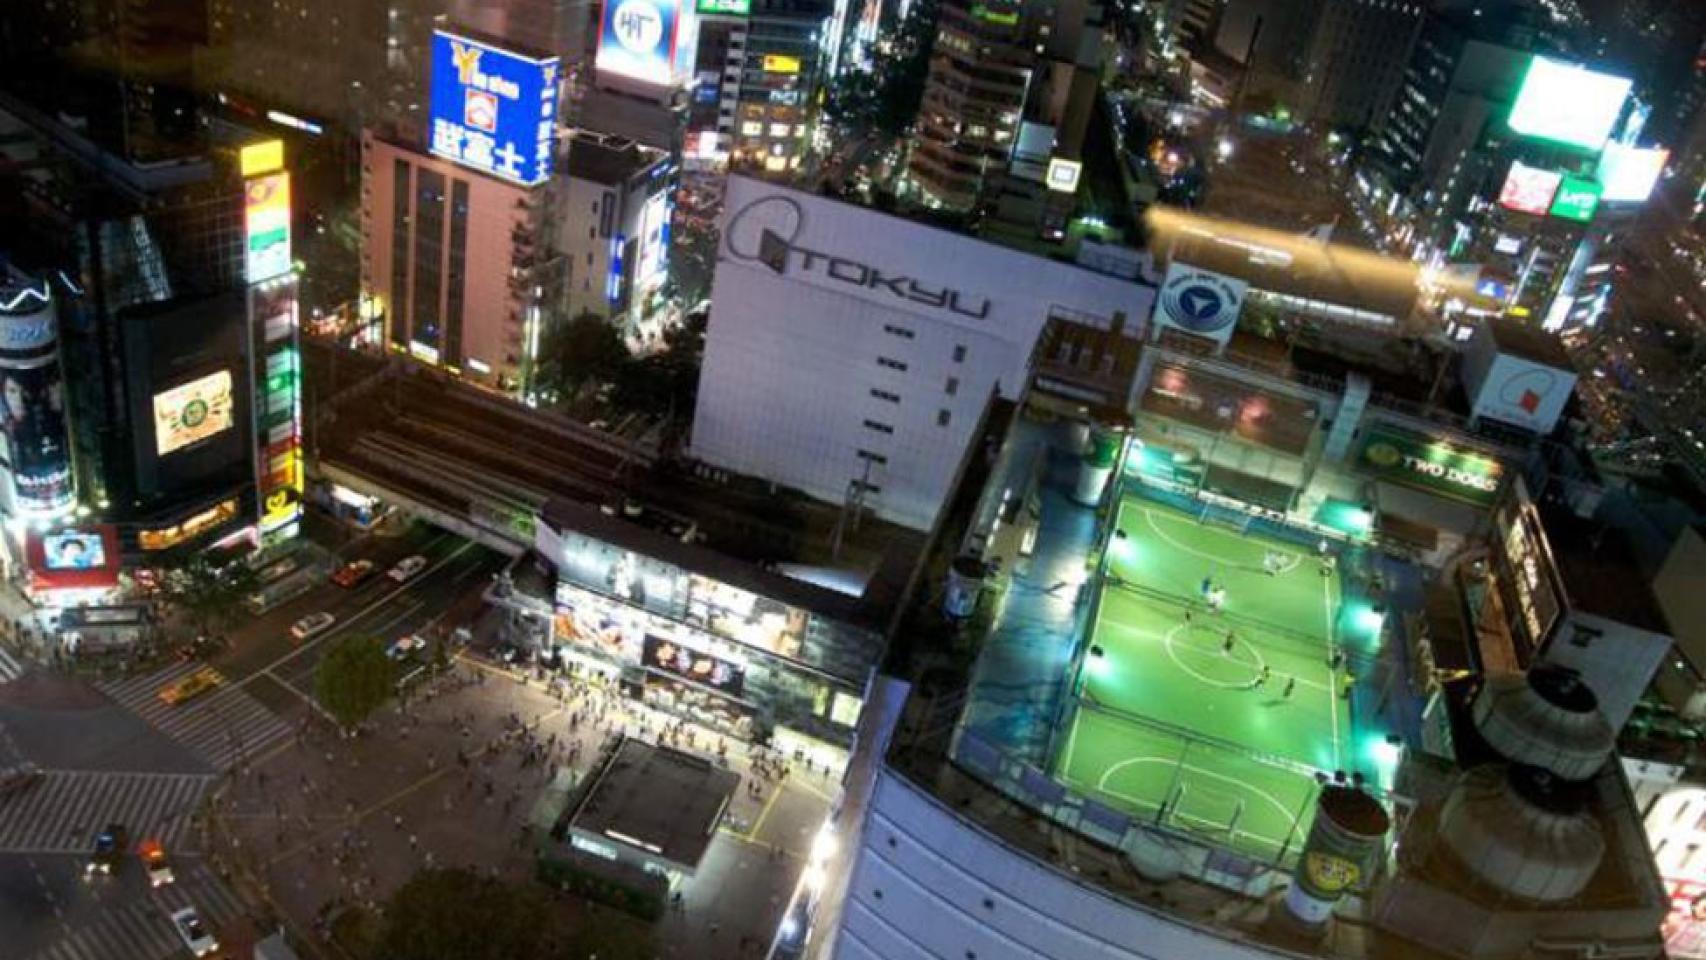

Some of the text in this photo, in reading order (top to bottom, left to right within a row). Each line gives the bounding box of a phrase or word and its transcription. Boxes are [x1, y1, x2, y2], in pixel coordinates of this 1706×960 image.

[787, 245, 993, 321] TOKYU
[1404, 455, 1499, 492] TWO DOGS
